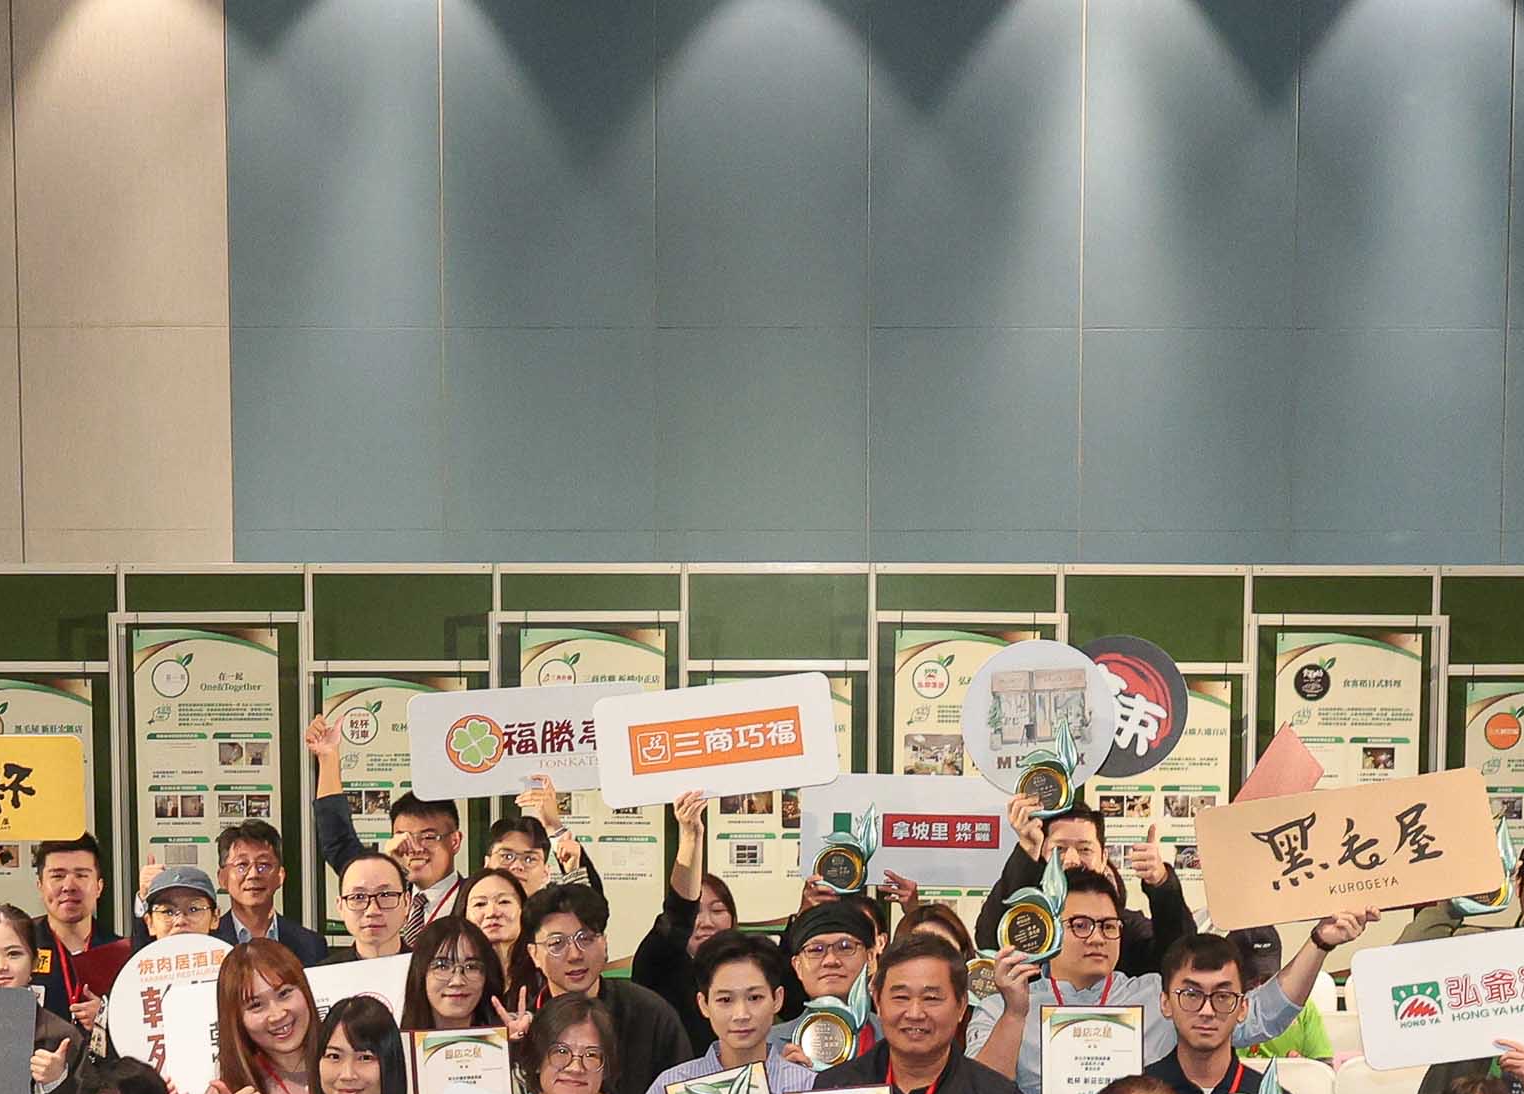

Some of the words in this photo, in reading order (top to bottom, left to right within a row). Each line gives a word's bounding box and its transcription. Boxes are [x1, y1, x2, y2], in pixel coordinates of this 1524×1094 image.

[673, 719, 797, 758] 三商巧福
[891, 820, 949, 841] 拿坡里
[1250, 802, 1444, 891] 黑毛屋
[1328, 875, 1399, 895] KUROGEYA
[1400, 1019, 1426, 1029] HONG
[1429, 1017, 1442, 1026] YA
[1451, 1005, 1490, 1023] HONG
[1492, 1004, 1509, 1017] YA
